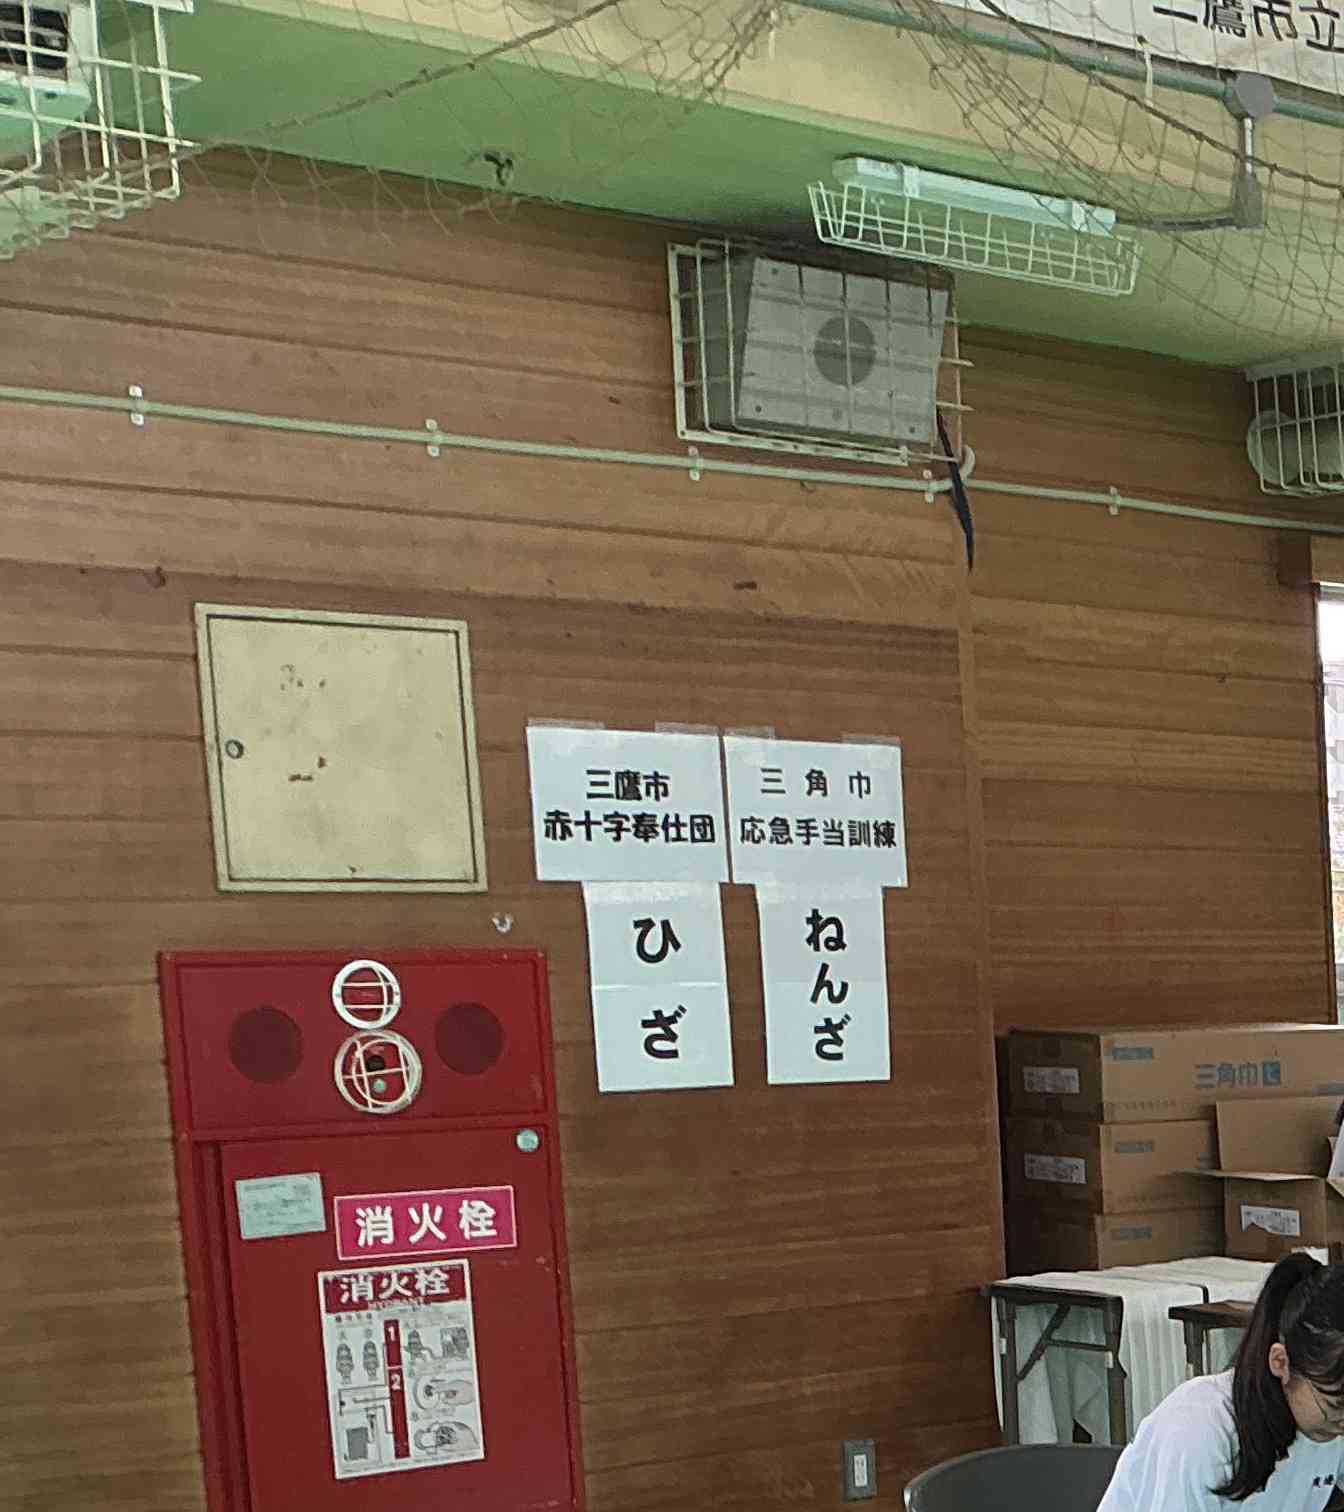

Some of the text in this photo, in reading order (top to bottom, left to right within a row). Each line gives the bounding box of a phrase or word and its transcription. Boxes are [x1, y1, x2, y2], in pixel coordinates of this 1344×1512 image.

[586, 769, 670, 802] 三鷹市
[760, 768, 872, 799] 三角巾
[544, 810, 716, 844] 赤十字奉仕団
[740, 816, 897, 849] 応急手当訓練
[633, 917, 687, 1060] ひざ
[805, 908, 852, 1061] ねんざ
[355, 1199, 498, 1248] 消火栓
[339, 1267, 450, 1304] 消火栓
